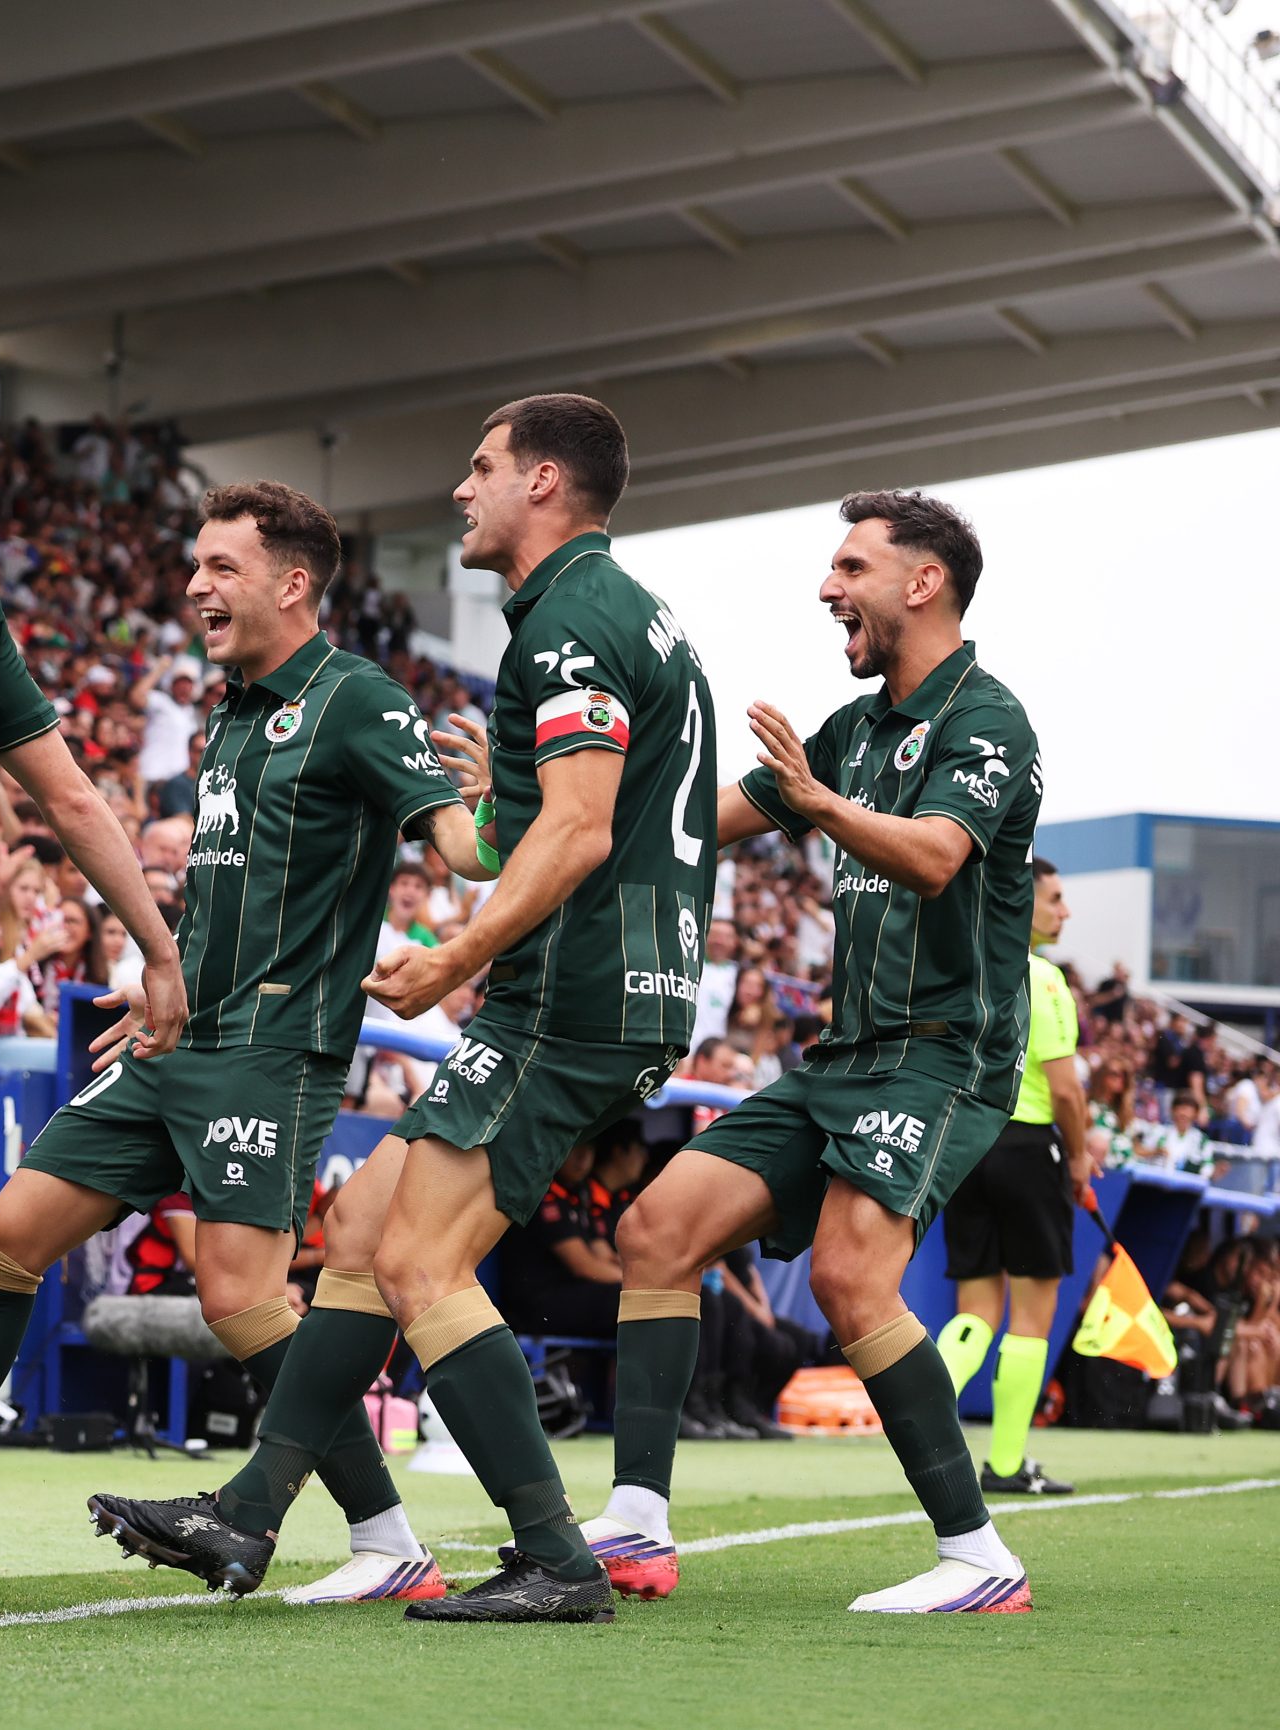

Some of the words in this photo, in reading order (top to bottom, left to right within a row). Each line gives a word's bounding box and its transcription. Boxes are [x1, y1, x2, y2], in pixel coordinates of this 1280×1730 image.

[671, 680, 703, 867] 2
[951, 769, 1000, 808] MGS
[447, 1059, 487, 1085] GROUP
[202, 1116, 279, 1148] JOVE
[871, 1133, 918, 1154] GROUP
[229, 1141, 276, 1158] GROUP
